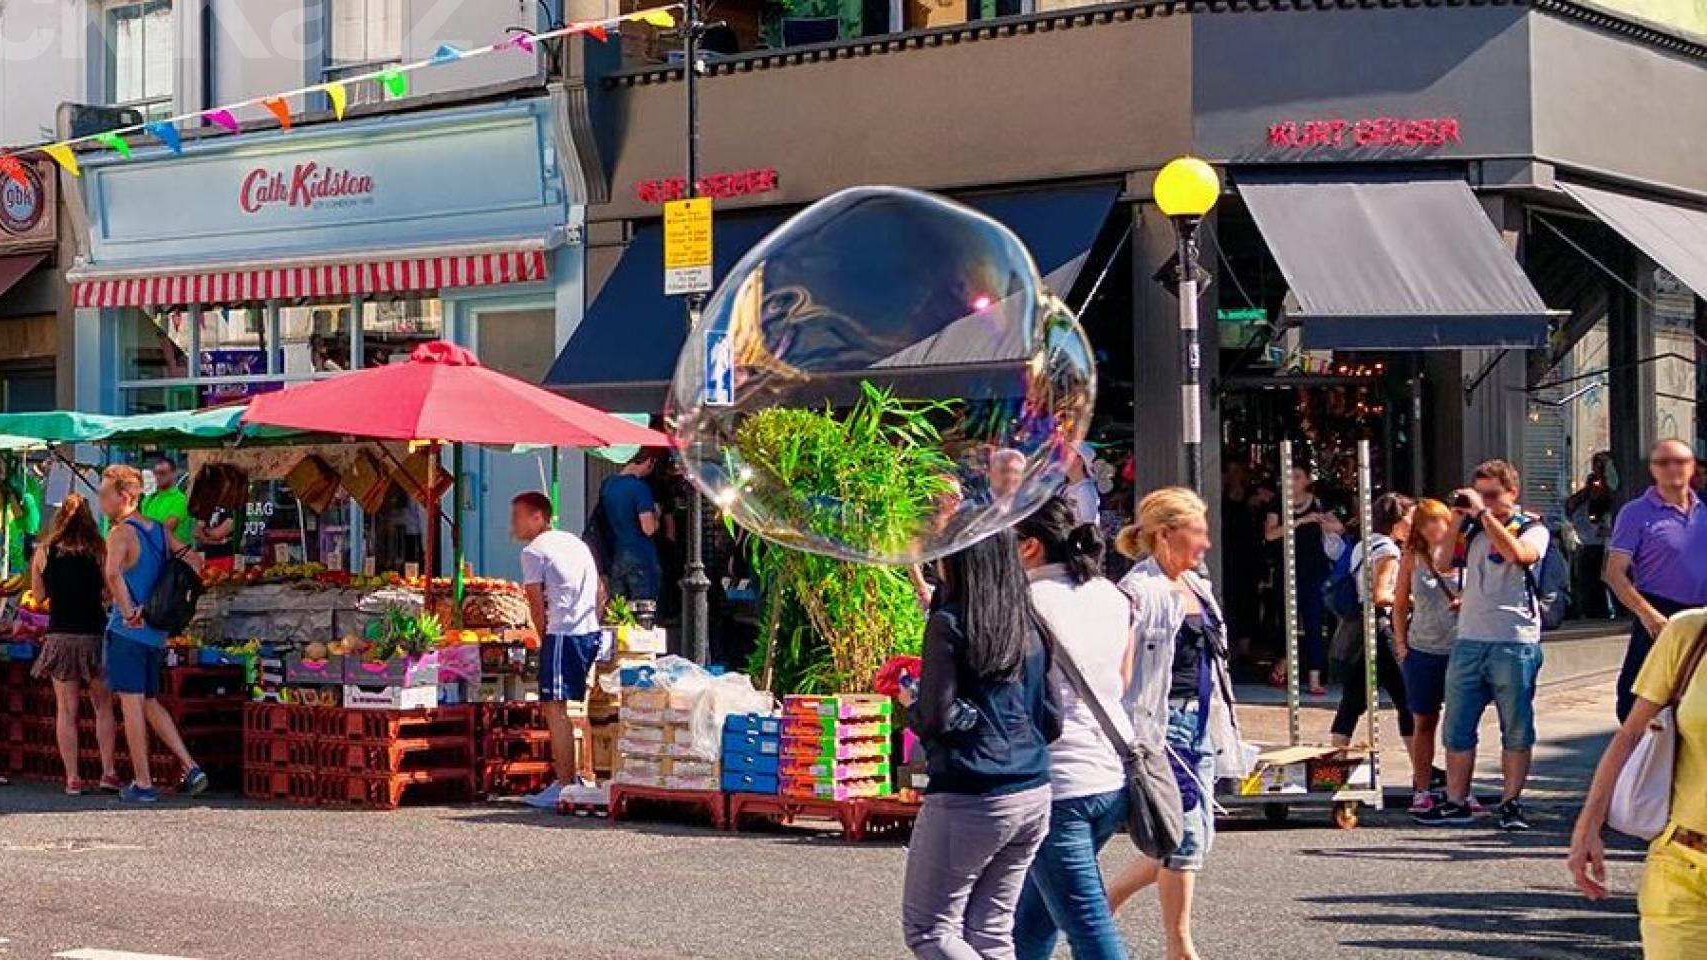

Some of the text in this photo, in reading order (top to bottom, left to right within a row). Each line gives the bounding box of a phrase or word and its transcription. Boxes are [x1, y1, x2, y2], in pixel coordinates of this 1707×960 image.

[1268, 116, 1461, 148] KURT GEIGER
[240, 160, 375, 214] Cath Kidston
